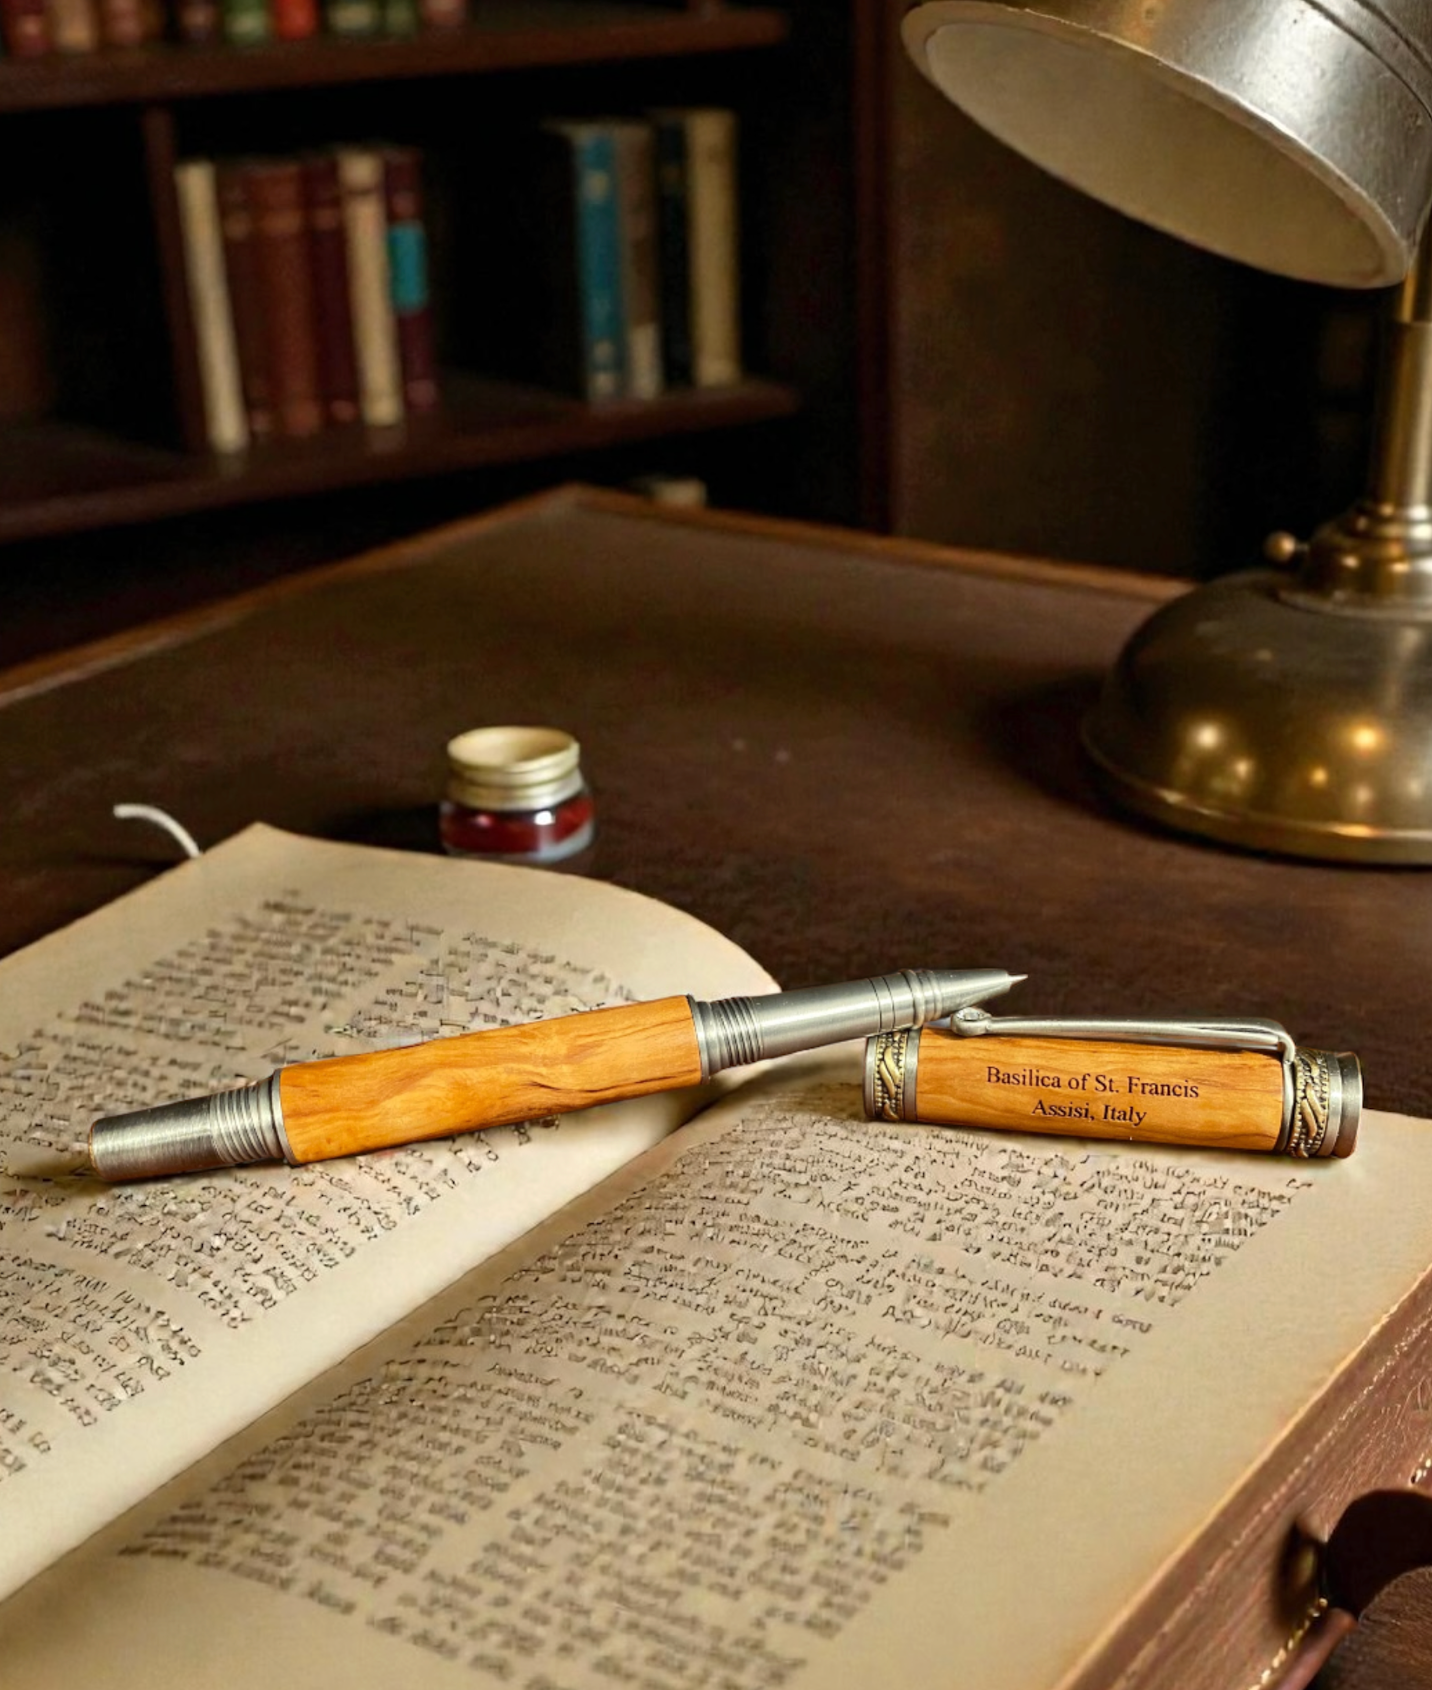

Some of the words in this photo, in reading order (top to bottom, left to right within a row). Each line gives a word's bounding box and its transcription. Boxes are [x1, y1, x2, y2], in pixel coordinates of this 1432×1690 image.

[986, 1066, 1062, 1089] Basilica
[1067, 1073, 1091, 1091] of
[1094, 1074, 1119, 1094] St.
[1127, 1076, 1199, 1098] Francis
[1031, 1099, 1095, 1122] Assisi,
[1101, 1104, 1147, 1126] Italy
